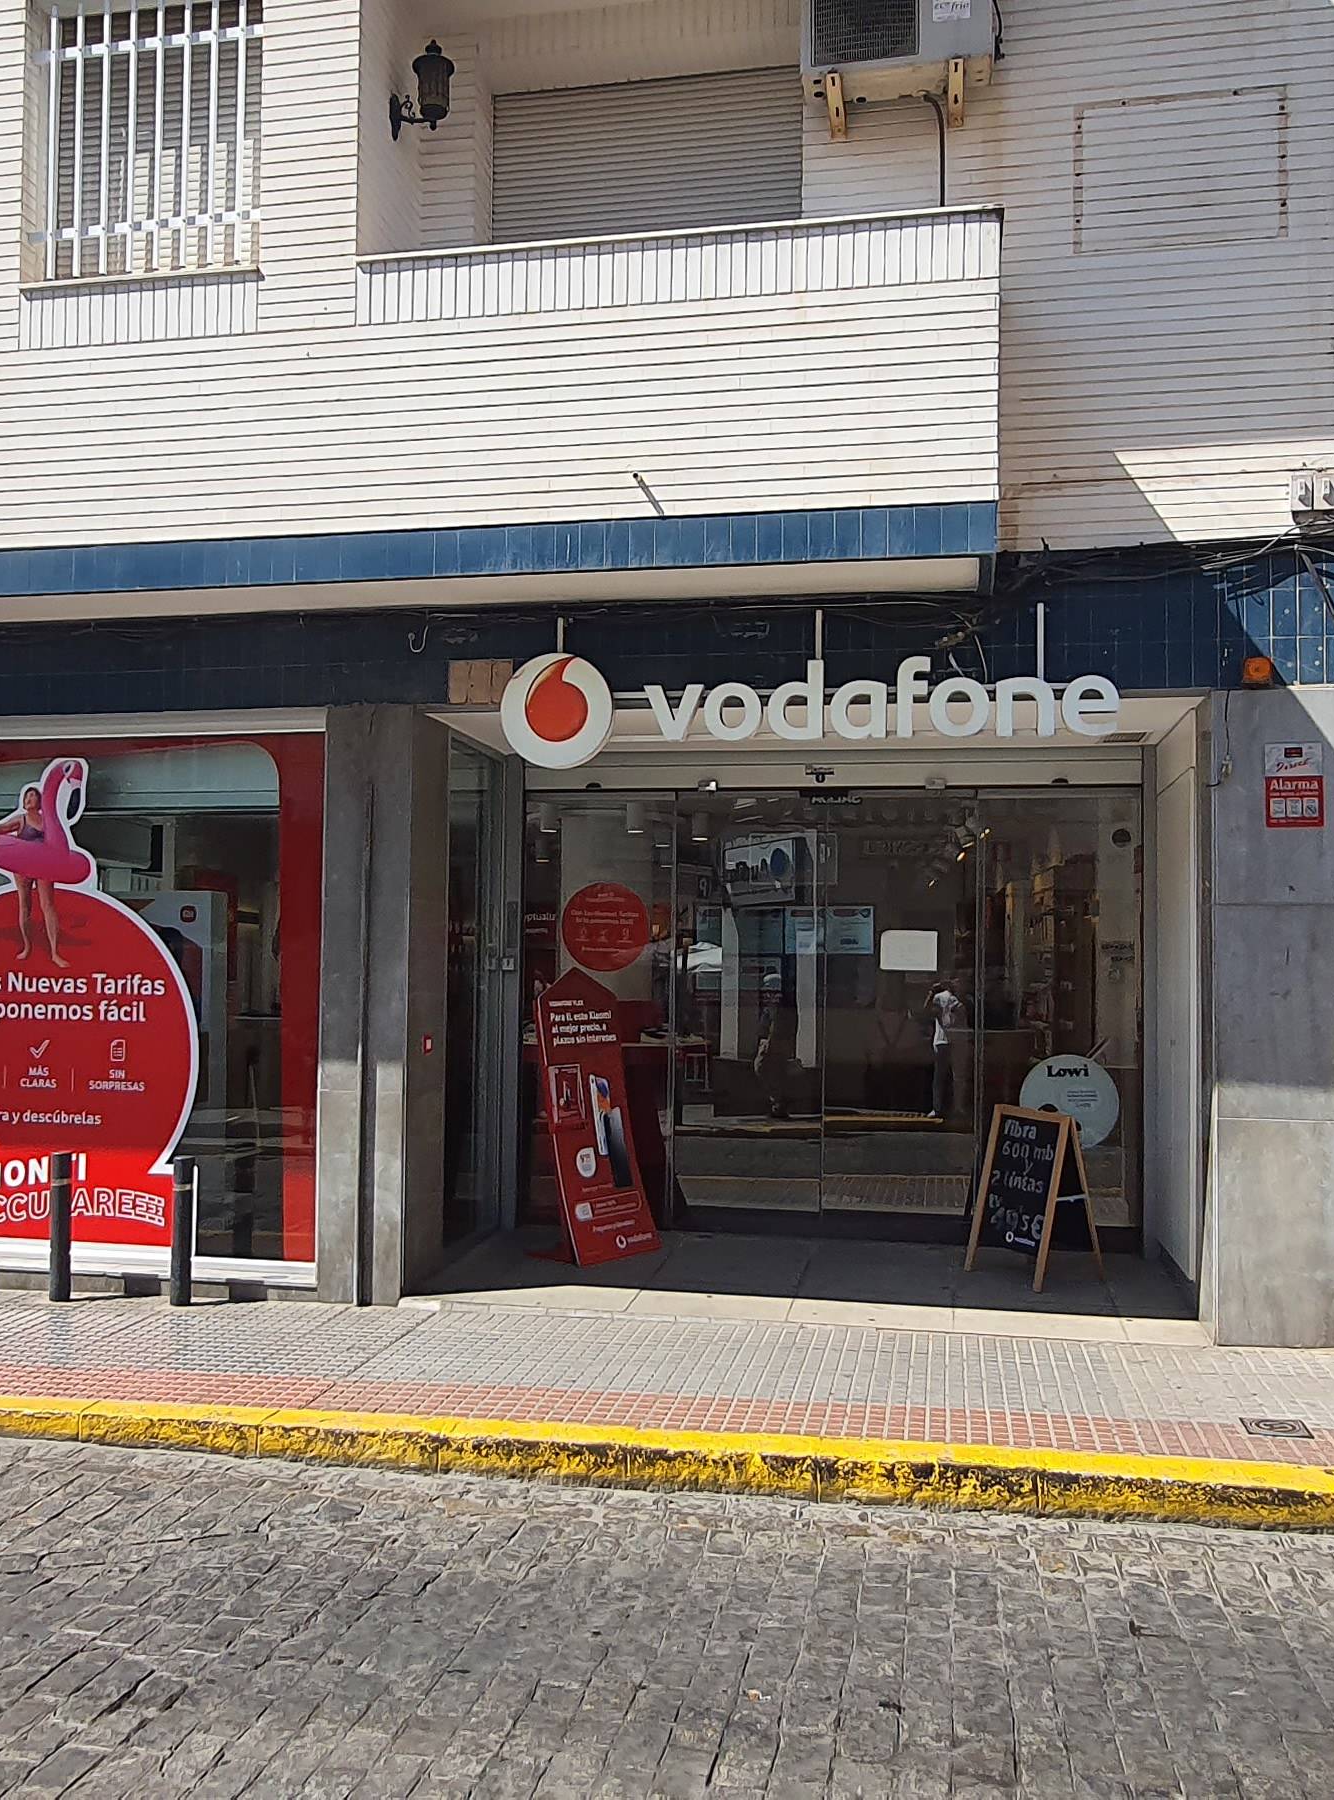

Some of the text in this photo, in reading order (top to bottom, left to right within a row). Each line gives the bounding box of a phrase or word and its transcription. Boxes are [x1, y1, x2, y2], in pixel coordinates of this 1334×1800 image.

[643, 655, 1122, 742] vodafone
[1270, 778, 1319, 791] Alarma
[7, 972, 87, 994] Nuevas
[92, 973, 166, 996] Tarifas
[99, 1000, 146, 1022] fácil
[29, 1066, 49, 1077] MÁS
[109, 1069, 126, 1080] SIN
[1047, 1064, 1090, 1078] Lowi
[20, 1078, 57, 1089] CLARAS
[89, 1080, 146, 1092] SORPRESAS
[11, 1111, 20, 1125] y
[22, 1109, 103, 1125] descúbrelas
[1002, 1141, 1030, 1159] 600
